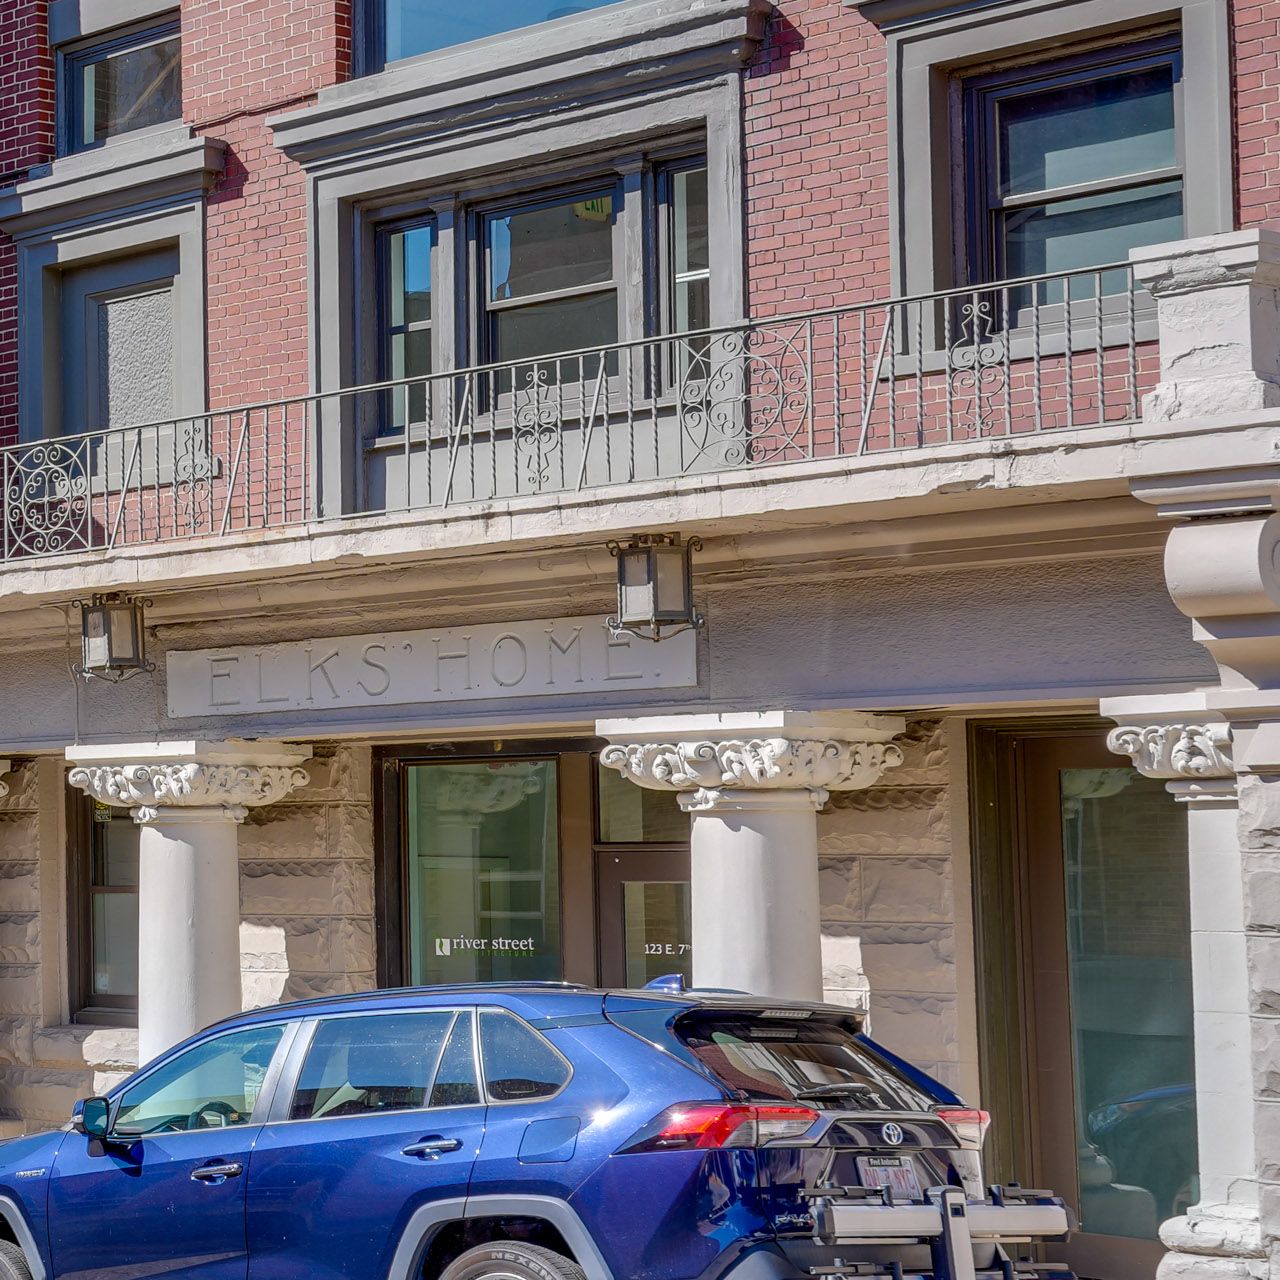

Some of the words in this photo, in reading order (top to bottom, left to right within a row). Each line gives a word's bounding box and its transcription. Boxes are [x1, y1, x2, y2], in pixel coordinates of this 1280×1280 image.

[453, 934, 488, 950] river
[492, 937, 535, 951] street
[644, 943, 662, 955] 123
[665, 943, 676, 955] E.
